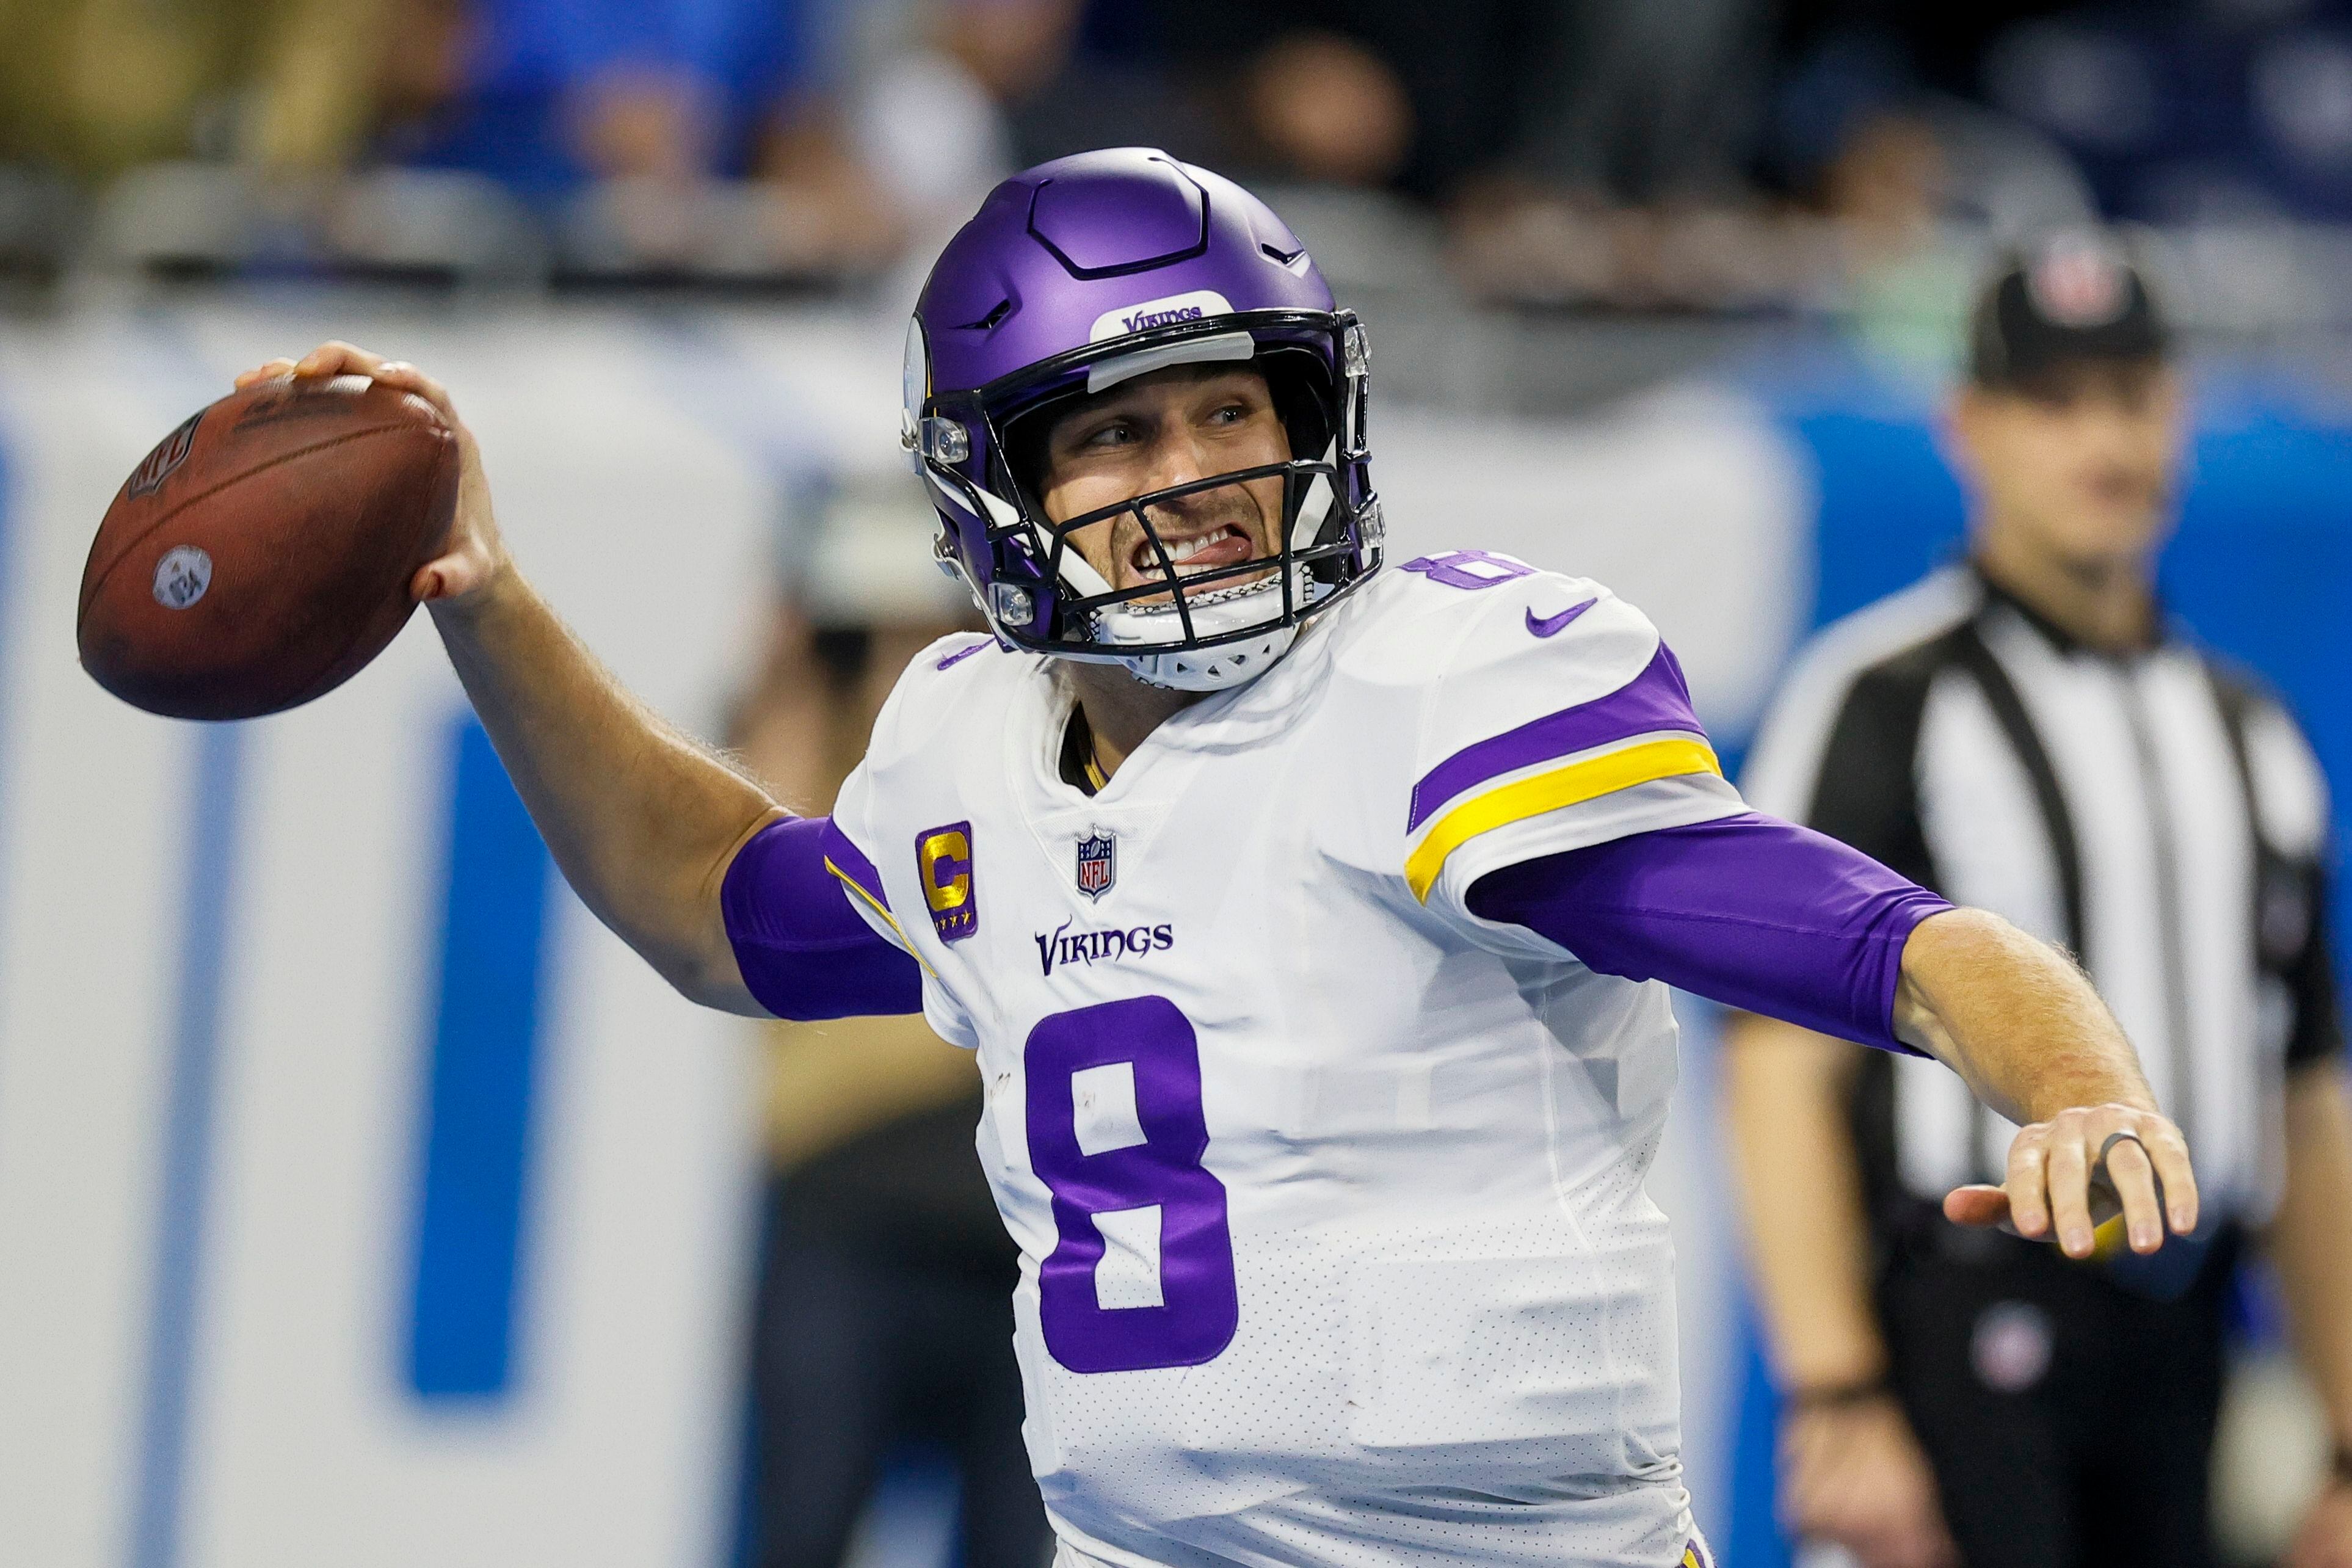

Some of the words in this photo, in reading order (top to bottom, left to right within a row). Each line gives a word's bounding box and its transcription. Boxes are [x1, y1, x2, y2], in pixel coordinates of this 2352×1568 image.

[921, 831, 968, 912] C
[1081, 860, 1108, 889] NFL
[1025, 995, 1239, 1374] 8
